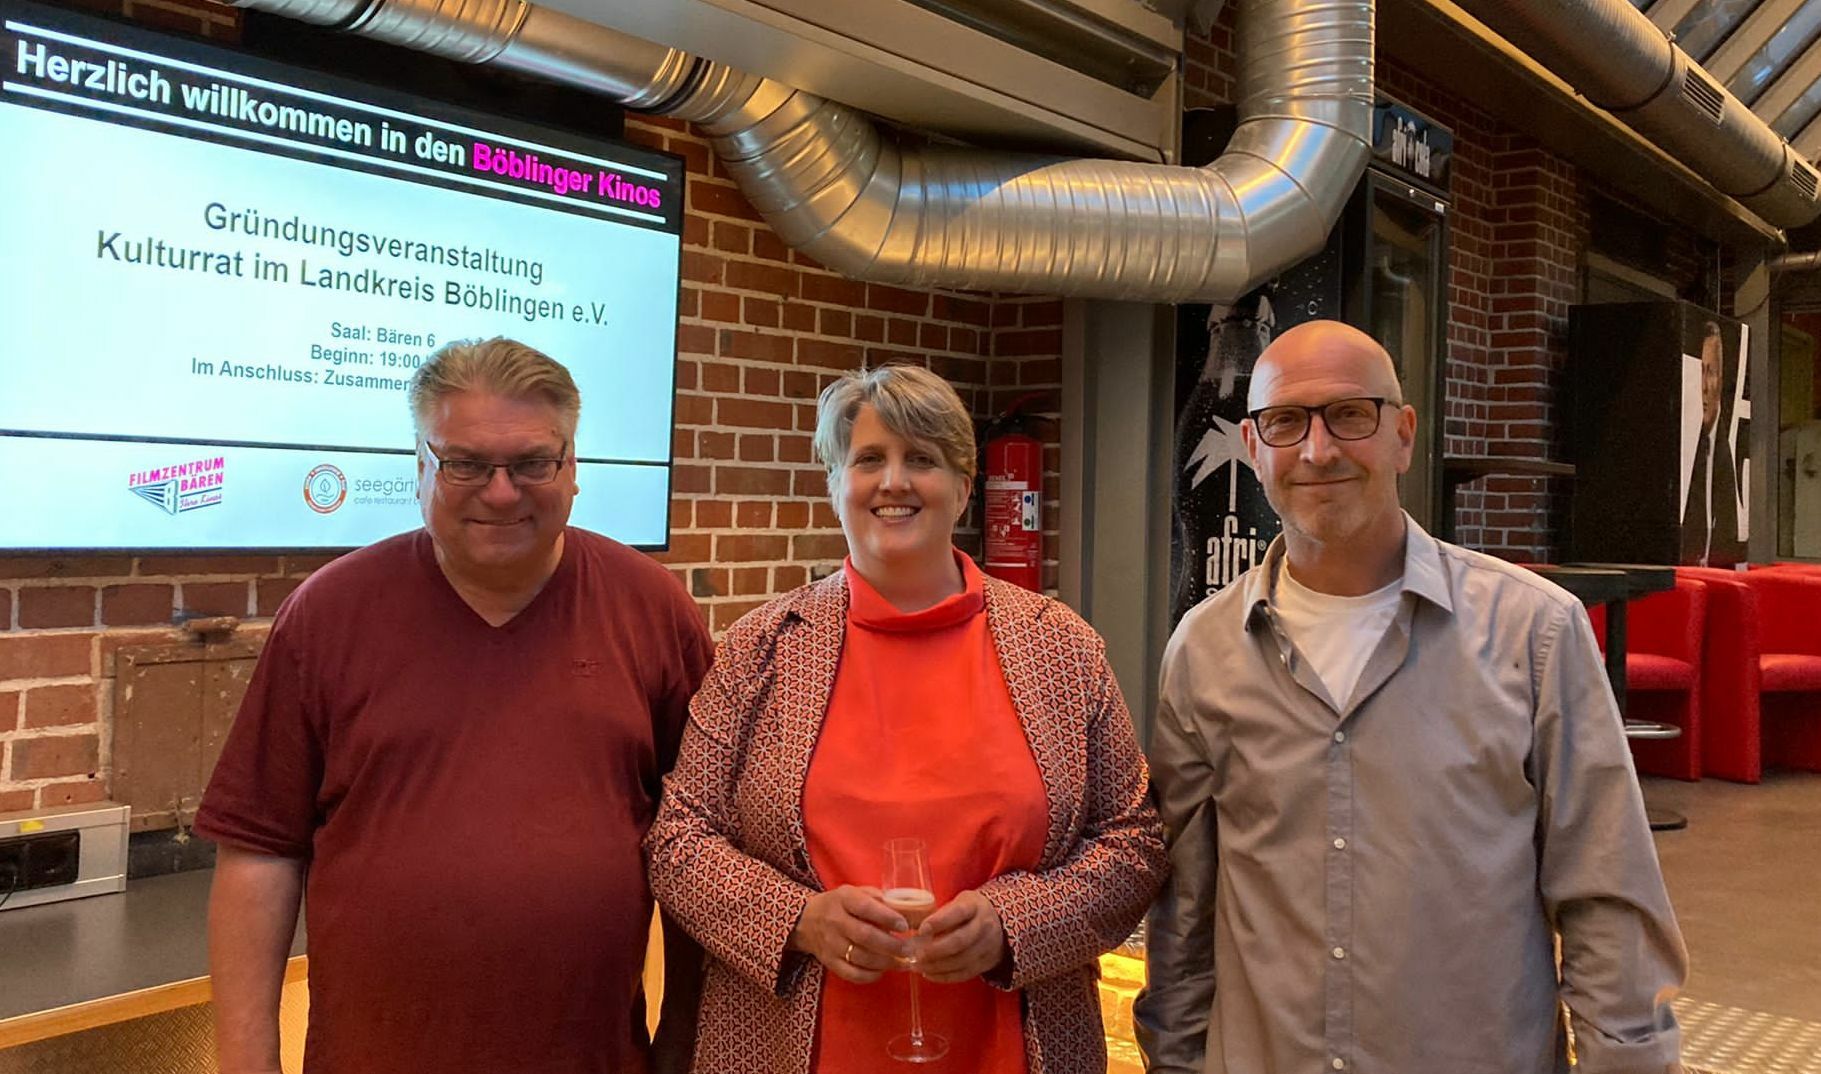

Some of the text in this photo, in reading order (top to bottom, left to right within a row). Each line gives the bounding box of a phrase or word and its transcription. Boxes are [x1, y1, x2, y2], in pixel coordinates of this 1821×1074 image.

[16, 39, 662, 209] Herzlich willkommen in den Böblinger Kinos
[203, 201, 544, 286] Gründungsveranstaltung
[96, 229, 609, 327] Kulturrat im Landkreis Böblingen e.V.
[330, 321, 437, 348] Saal: Bären 6
[191, 357, 214, 376] Im
[218, 360, 319, 385] Anschluss:
[310, 344, 375, 366] Beginn:
[379, 350, 421, 369] 19:00
[128, 456, 225, 487] FILMZENTRUM
[180, 471, 224, 492] BÄREN
